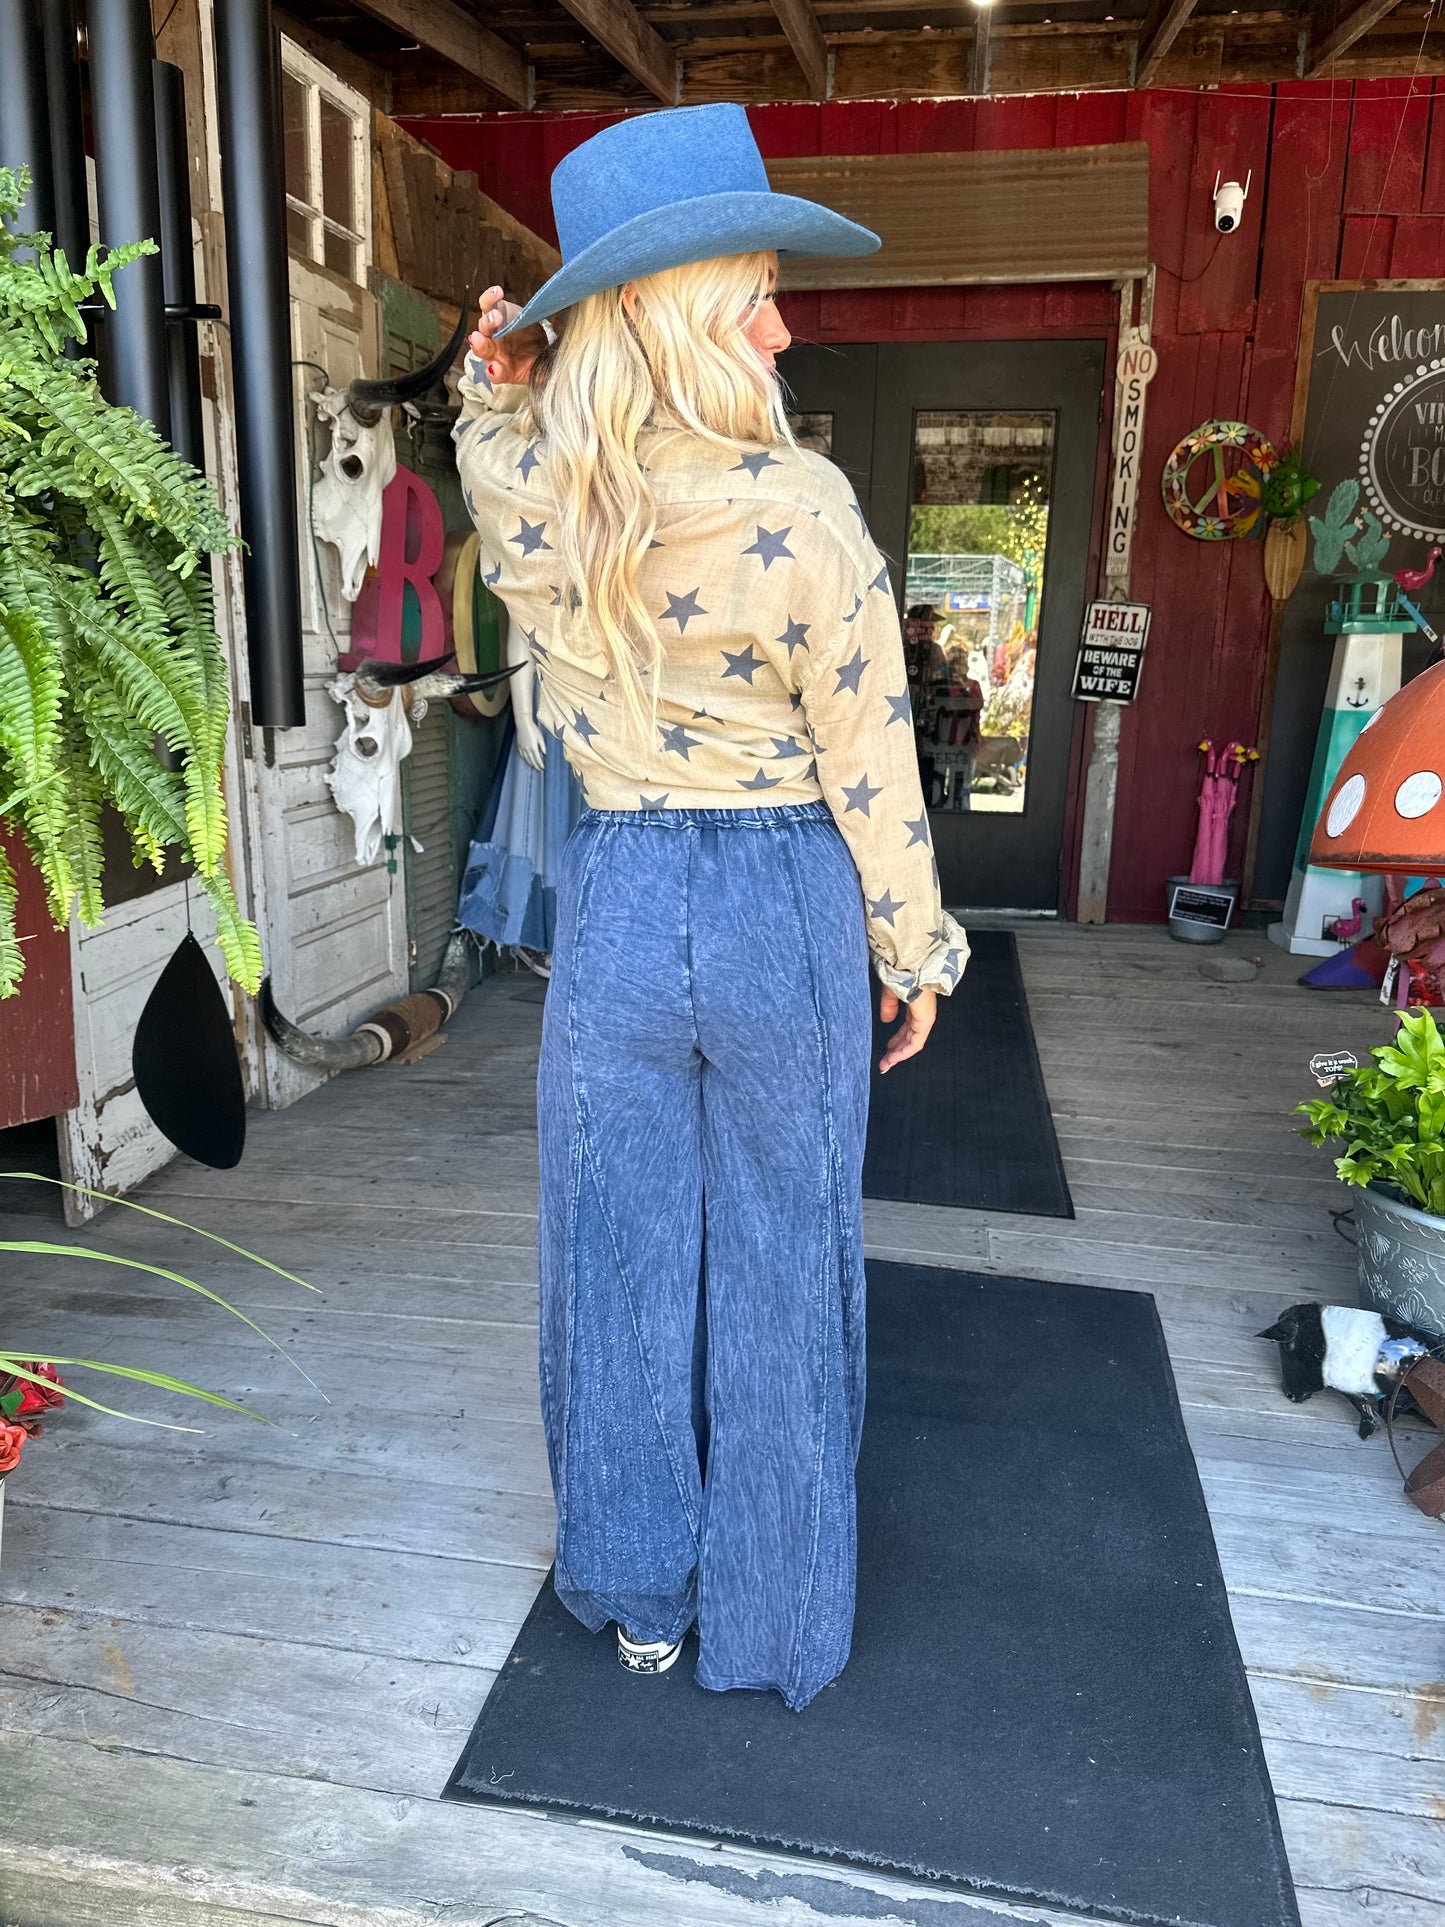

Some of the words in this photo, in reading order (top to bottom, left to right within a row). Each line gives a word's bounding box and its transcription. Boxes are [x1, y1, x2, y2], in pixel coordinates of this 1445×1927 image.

[1123, 350, 1152, 375] NO
[1112, 378, 1141, 554] SMOKING
[1091, 608, 1142, 634] HELL
[1089, 633, 1109, 643] WITH
[1110, 635, 1124, 645] THE
[1083, 649, 1137, 668] BEWARE
[1092, 665, 1105, 676] OF
[1106, 667, 1123, 677] THE
[1080, 675, 1132, 694] WIFE
